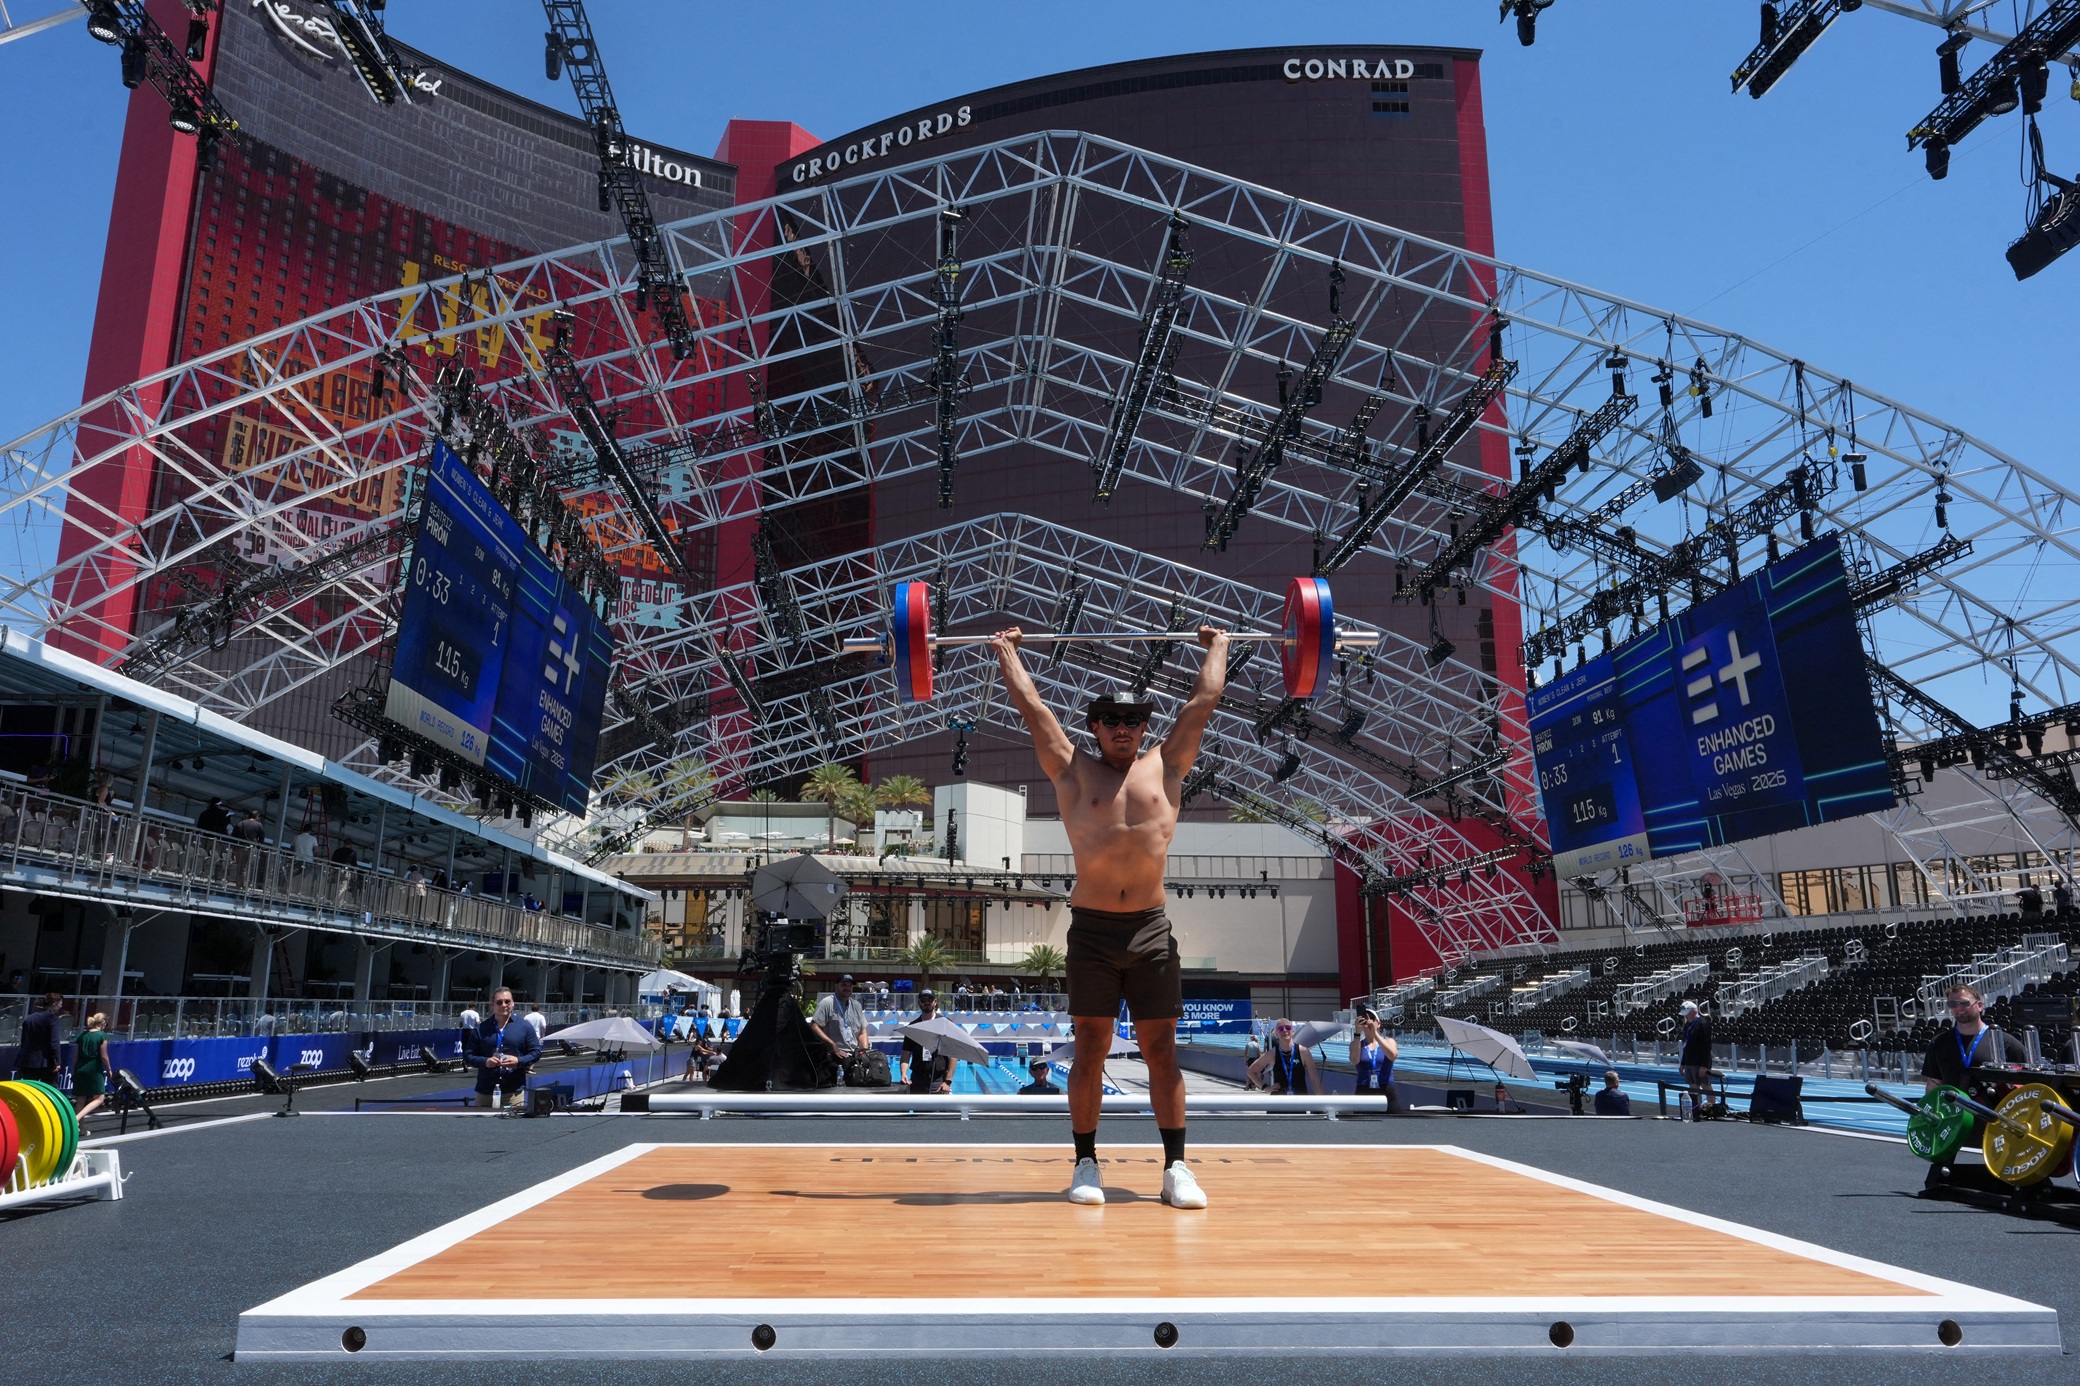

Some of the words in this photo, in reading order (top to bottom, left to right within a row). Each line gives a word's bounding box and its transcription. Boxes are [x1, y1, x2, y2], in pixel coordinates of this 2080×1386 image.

[1283, 58, 1415, 79] CONRAD
[793, 105, 971, 183] CROCKFORDS
[608, 141, 702, 188] Hilton
[451, 468, 473, 496] WOMEN'S
[473, 490, 487, 514] CLEAN
[429, 501, 453, 532] BEATRIZ
[426, 515, 450, 547] PIRÓN
[415, 557, 451, 605] 0:33
[470, 584, 475, 595] 2
[482, 594, 487, 604] 3
[492, 568, 501, 588] 91
[501, 581, 510, 599] Kg
[490, 603, 508, 622] ATTEMPT
[491, 621, 500, 647] 1
[435, 640, 461, 678] 115
[461, 670, 470, 689] Kg
[1537, 690, 1555, 706] WOMEN'S
[1556, 684, 1570, 698] CLEAN
[1576, 675, 1588, 687] JERK
[539, 689, 572, 729] ENHANCED
[1592, 709, 1604, 724] 91
[1606, 708, 1615, 721] Kg
[419, 709, 436, 729] WORLD
[436, 721, 455, 738] RECORD
[460, 730, 475, 752] 126
[540, 713, 564, 746] GAMES
[1534, 728, 1552, 743] BEATRIZ
[1601, 729, 1622, 744] ATTEMPT
[1698, 714, 1776, 757] ENHANCED
[532, 734, 540, 749] Las
[539, 739, 550, 760] Vegas
[550, 750, 565, 770] 2026
[1536, 739, 1553, 755] PIRÓN
[1592, 739, 1597, 748] 3
[1611, 743, 1622, 764] 1
[1713, 743, 1767, 775] GAMES
[1541, 763, 1568, 790] 0:33
[1707, 786, 1722, 801] Las
[1722, 781, 1746, 798] Vegas
[1751, 769, 1787, 791] 2026
[1573, 799, 1596, 823] 115
[1598, 805, 1608, 818] Kg
[1579, 854, 1593, 866] WORLD
[1594, 851, 1611, 863] RECORD
[1618, 843, 1634, 859] 126
[1191, 1012, 1220, 1020] MORE
[301, 1049, 323, 1069] zoop
[398, 1046, 410, 1060] Live
[162, 1058, 195, 1081] zoop
[1999, 1090, 2040, 1116] ROGUE
[1911, 1130, 1931, 1154] ROGUE
[1993, 1134, 2005, 1148] 15
[2003, 1147, 2048, 1175] ROGUE
